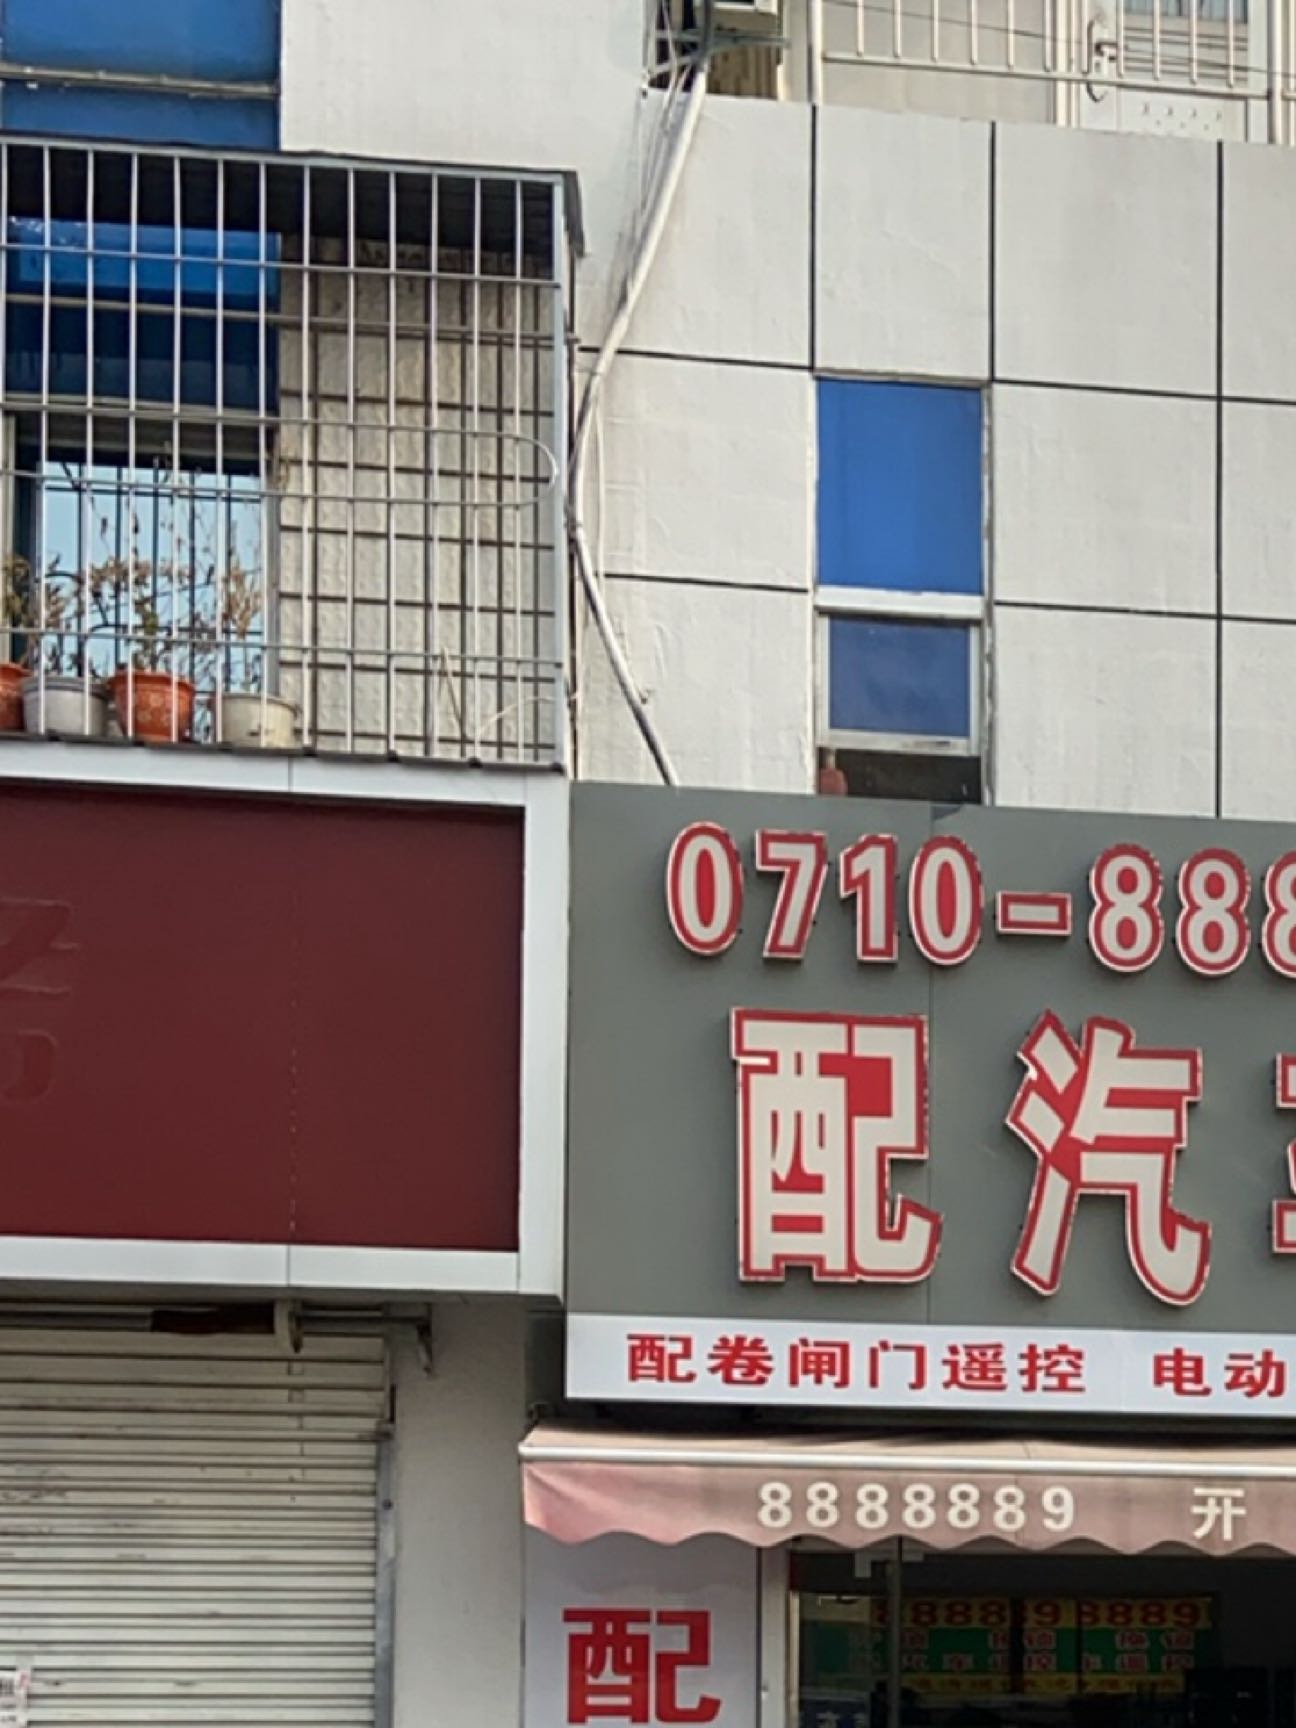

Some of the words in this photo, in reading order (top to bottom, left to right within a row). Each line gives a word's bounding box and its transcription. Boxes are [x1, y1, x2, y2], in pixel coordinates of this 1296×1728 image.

[627, 1333, 1086, 1393] 配卷闸门遥控
[758, 1481, 1075, 1532] 8888889
